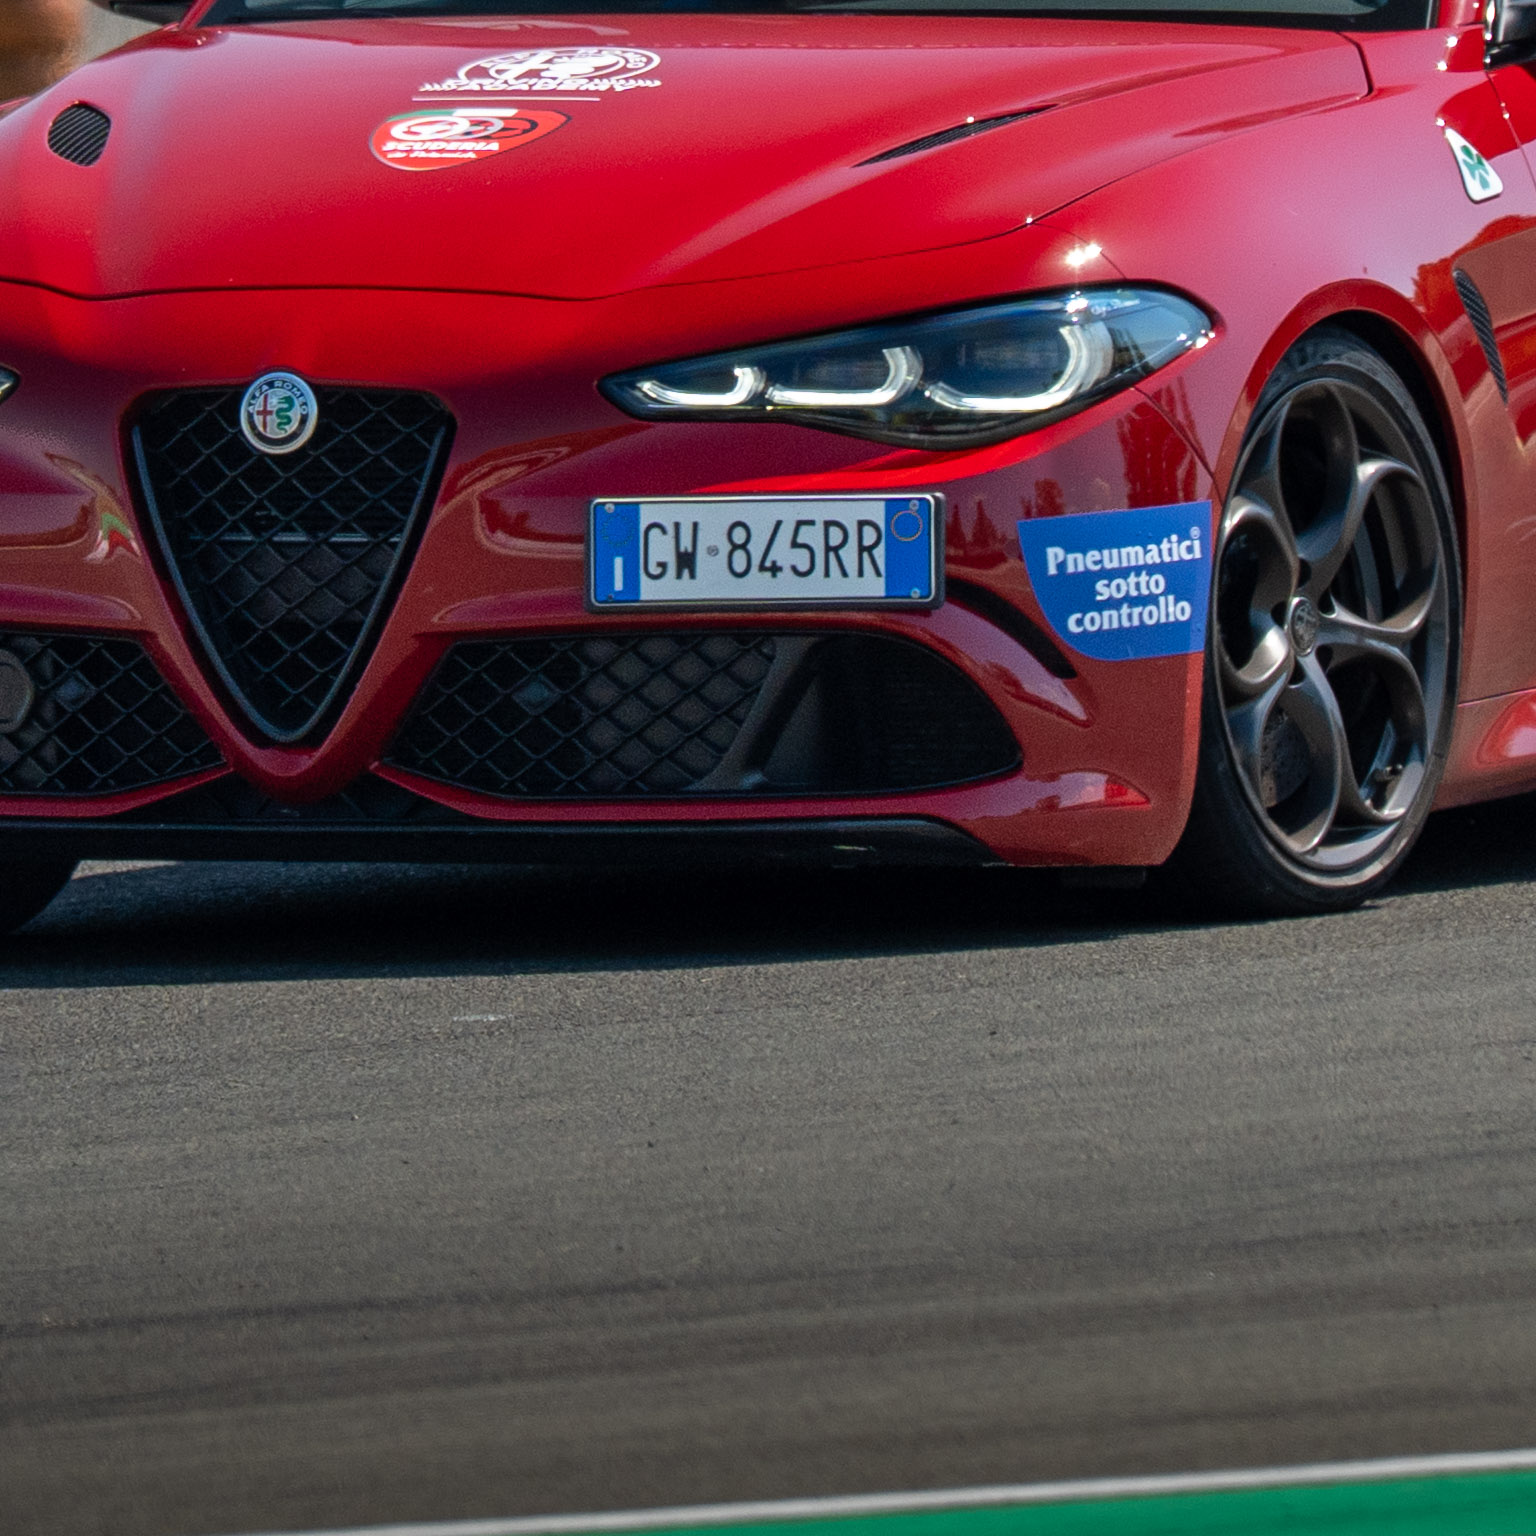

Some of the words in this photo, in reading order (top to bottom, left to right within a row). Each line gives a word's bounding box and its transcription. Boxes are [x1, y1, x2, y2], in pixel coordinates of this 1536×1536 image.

[247, 384, 270, 414] ALFA
[273, 380, 309, 416] ROMEO
[642, 520, 700, 581] GW
[726, 518, 884, 579] 845RR
[1045, 533, 1202, 577] Pneumatici
[1094, 569, 1166, 601] sotto
[1066, 594, 1193, 635] controllo
